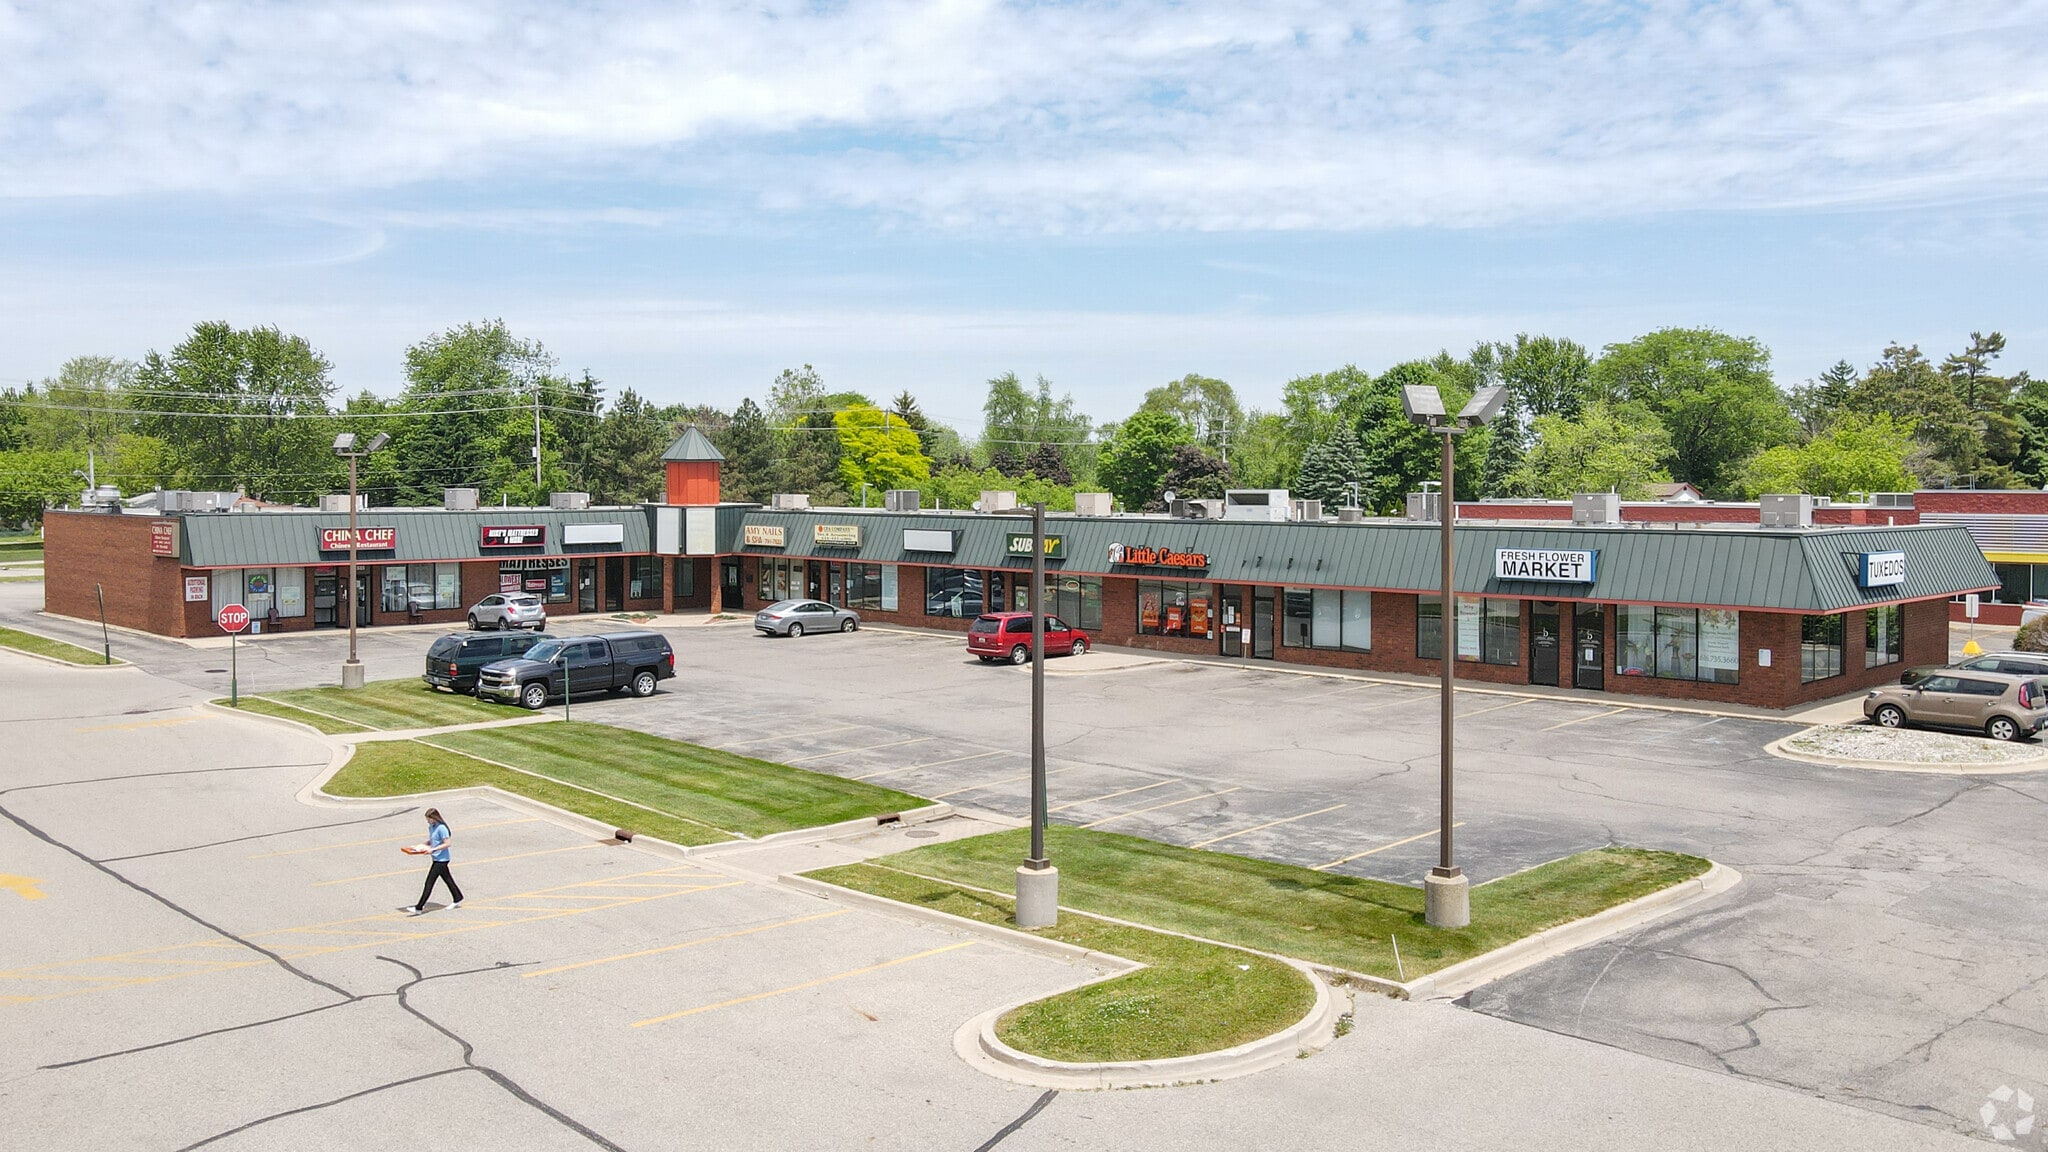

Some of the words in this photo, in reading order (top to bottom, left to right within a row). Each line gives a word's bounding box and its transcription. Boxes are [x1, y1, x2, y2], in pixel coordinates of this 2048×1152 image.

[324, 529, 361, 542] CHINA
[365, 529, 393, 541] CHEF
[746, 527, 761, 535] AMY
[762, 527, 783, 536] NAILS
[751, 536, 763, 544] SPA
[1009, 537, 1060, 554] SUBAY
[1126, 547, 1156, 565] Little
[1159, 548, 1205, 567] Caesars
[1501, 551, 1535, 561] FRESH
[1539, 552, 1584, 563] FLOWER
[1503, 561, 1582, 578] MARKET
[1869, 559, 1904, 578] TUXEDOS
[501, 575, 521, 584] LOWEST
[220, 612, 247, 624] STOP
